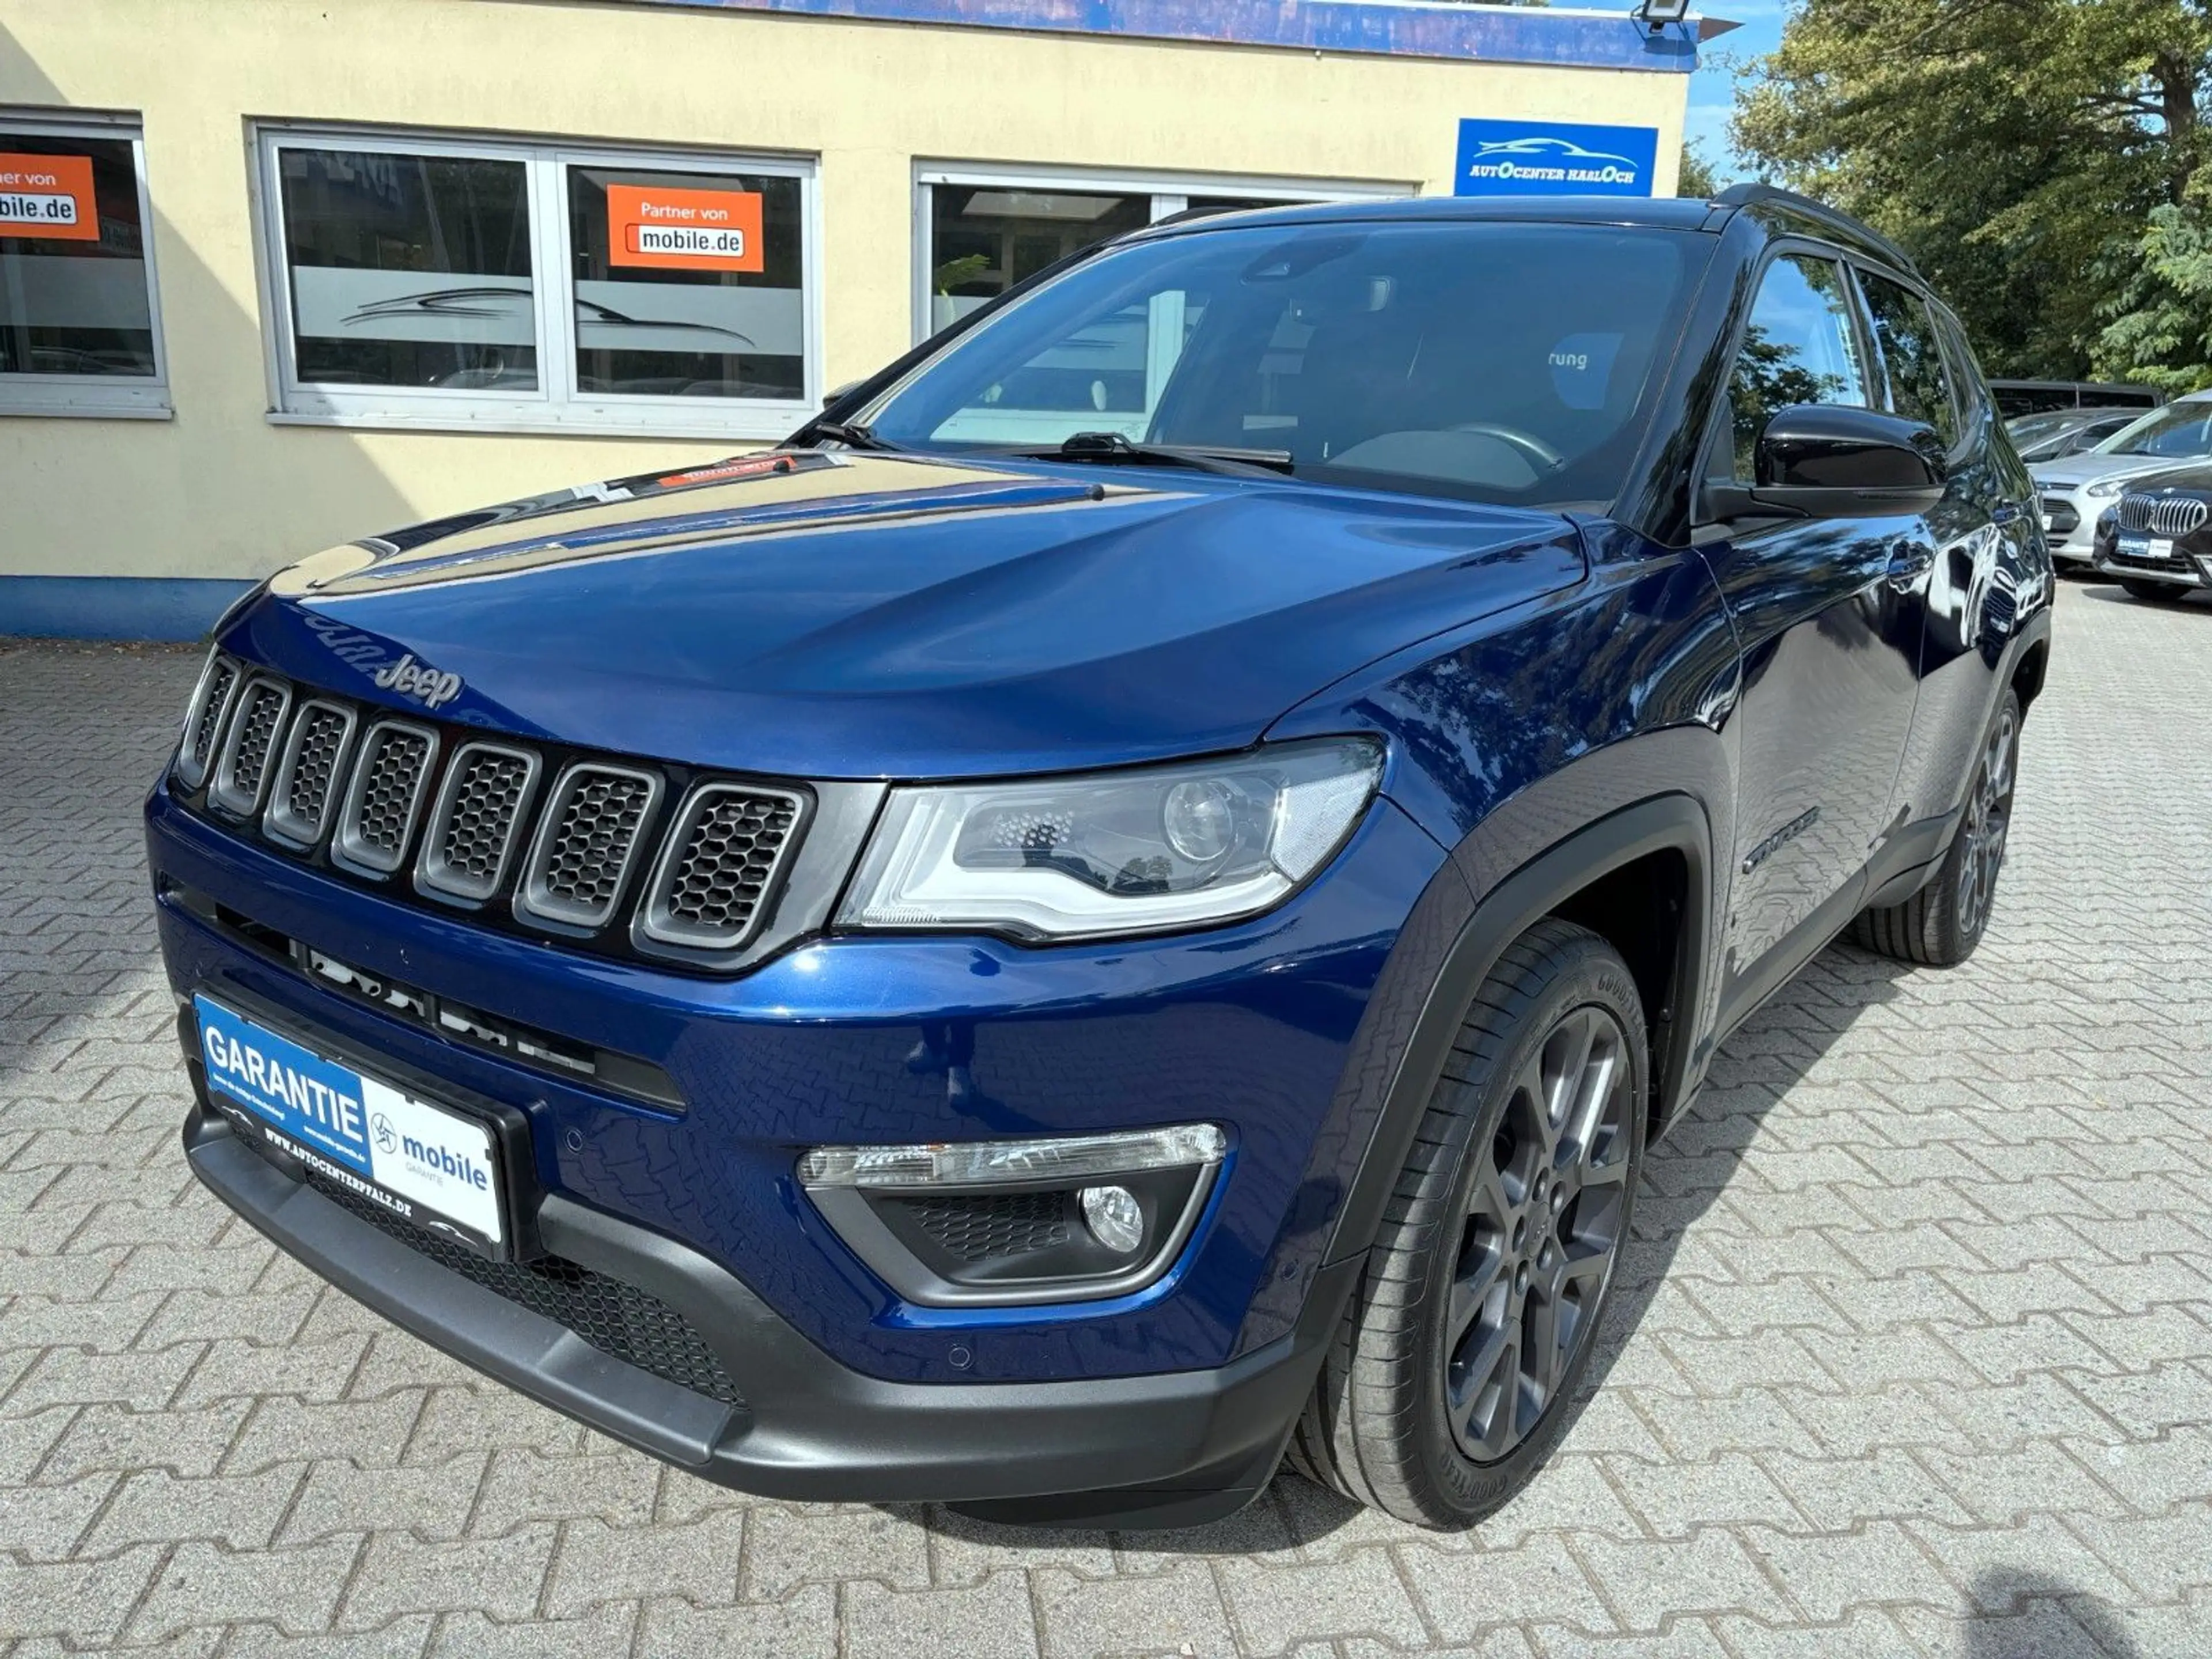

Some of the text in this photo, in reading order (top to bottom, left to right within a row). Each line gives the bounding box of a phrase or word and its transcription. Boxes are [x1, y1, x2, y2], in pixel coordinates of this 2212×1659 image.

[26, 174, 56, 185] von
[1469, 161, 1565, 180] AUTOCENTER
[641, 202, 728, 220] Partner von
[643, 230, 739, 251] mobile.de
[1548, 353, 1587, 370] rung
[374, 654, 463, 709] Jeep
[206, 1026, 363, 1144] GARANTIE
[265, 1128, 411, 1217] WWW.AUTOCENTERPFALZ.DE
[402, 1135, 487, 1191] mobile
